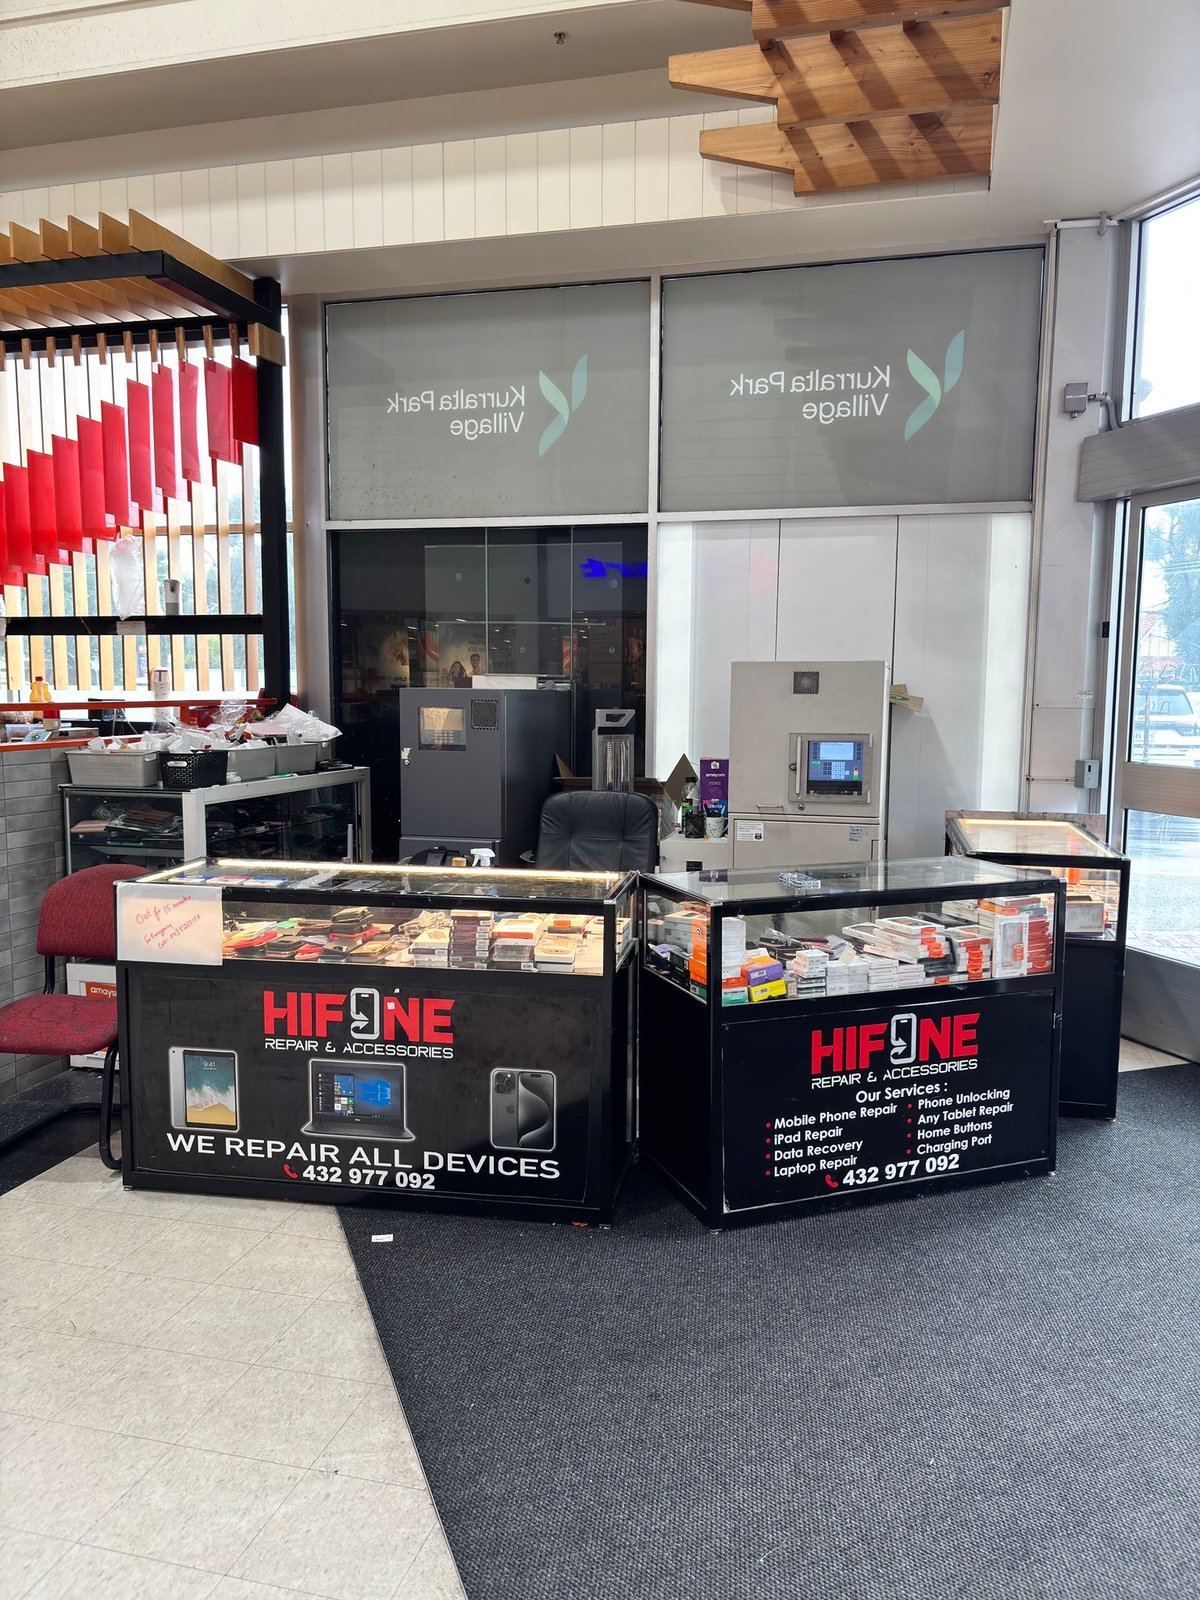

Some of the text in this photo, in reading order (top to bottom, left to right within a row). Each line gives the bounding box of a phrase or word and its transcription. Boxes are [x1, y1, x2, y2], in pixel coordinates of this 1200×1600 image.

[136, 908, 152, 925] Out
[163, 903, 171, 914] 15
[90, 986, 117, 998] amays
[264, 1038, 454, 1059] REPAIR & ACCESSORIES
[203, 1060, 216, 1068] 9:41
[811, 1058, 978, 1090] REPAIR & ACCESSORIES
[855, 1089, 882, 1104] Our
[884, 1083, 941, 1100] Services
[918, 1089, 1011, 1110] Phone Unlocking
[774, 1103, 898, 1129] Mobile Phone Repair
[917, 1102, 1014, 1125] Any Tablet Repair
[774, 1126, 843, 1145] iPad Repair
[917, 1121, 993, 1140] Home Buttons
[774, 1140, 863, 1161] Data Recovery
[916, 1134, 993, 1155] Charging Port
[166, 1132, 560, 1179] WE REPAIR ALL DEVICES
[774, 1154, 858, 1177] Laptop Repair
[302, 1165, 436, 1190] 432 977 092
[842, 1153, 960, 1186] 432 977 092
